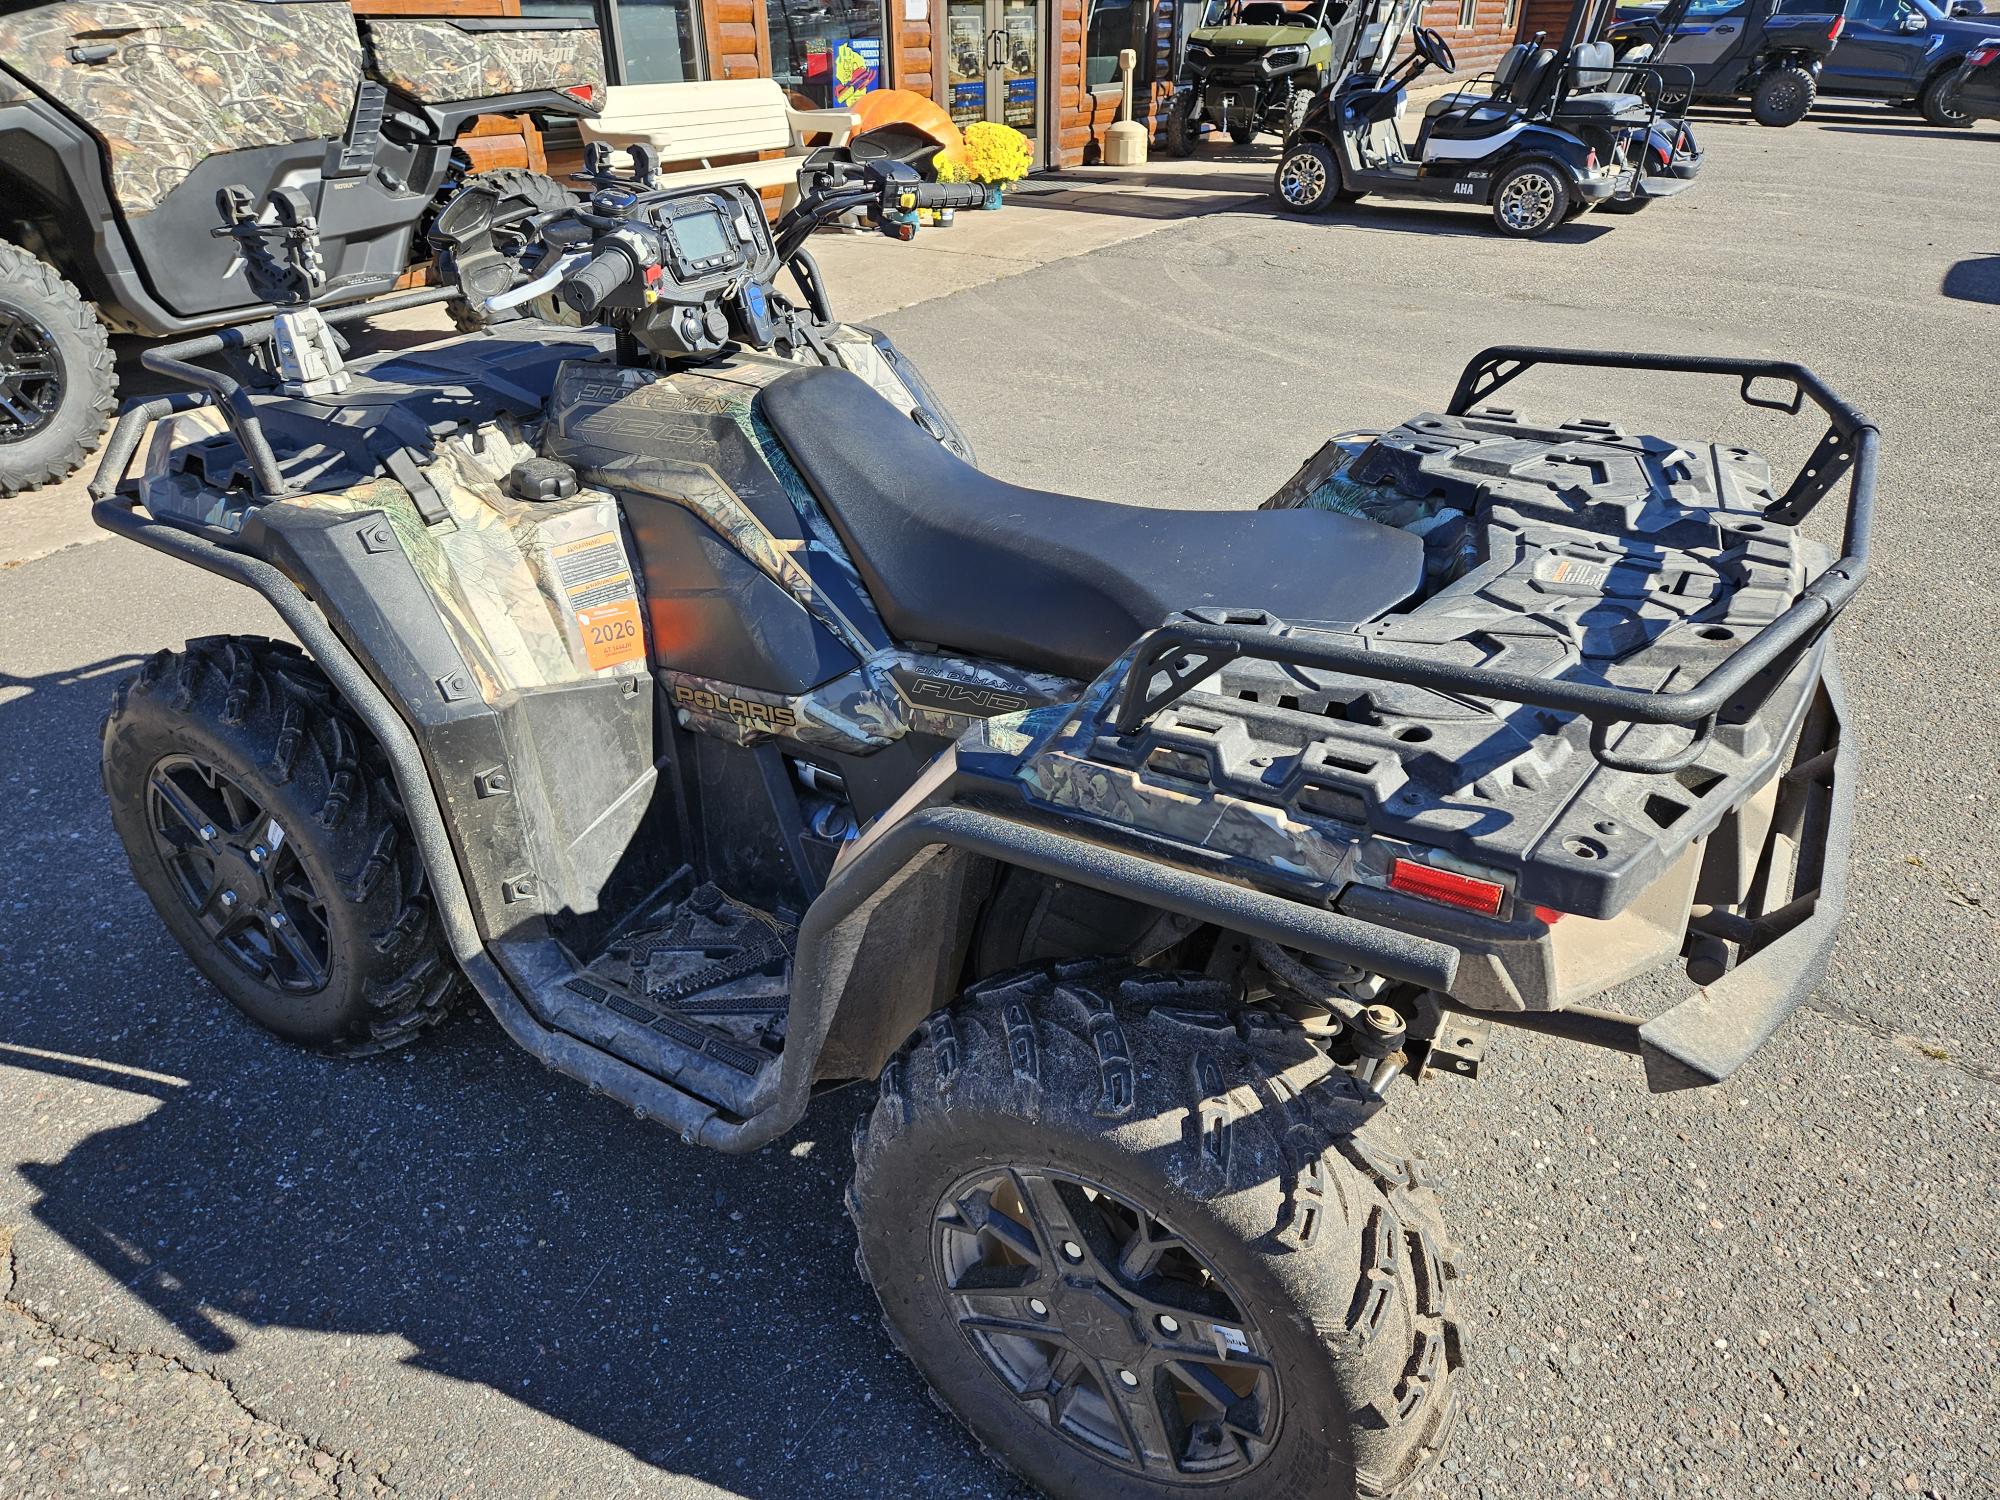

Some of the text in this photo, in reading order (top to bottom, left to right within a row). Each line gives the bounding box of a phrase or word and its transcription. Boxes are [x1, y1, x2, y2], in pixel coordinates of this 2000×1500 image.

[853, 40, 879, 49] SNOWMOBILE
[1453, 182, 1474, 195] AHA
[580, 384, 733, 415] SPORTSMAN
[572, 414, 709, 444] 850
[572, 538, 601, 552] WARNING
[590, 619, 635, 645] 2026
[915, 665, 1028, 693] ON DEMAND
[674, 684, 796, 727] POLARIS
[911, 678, 1029, 712] AWD
